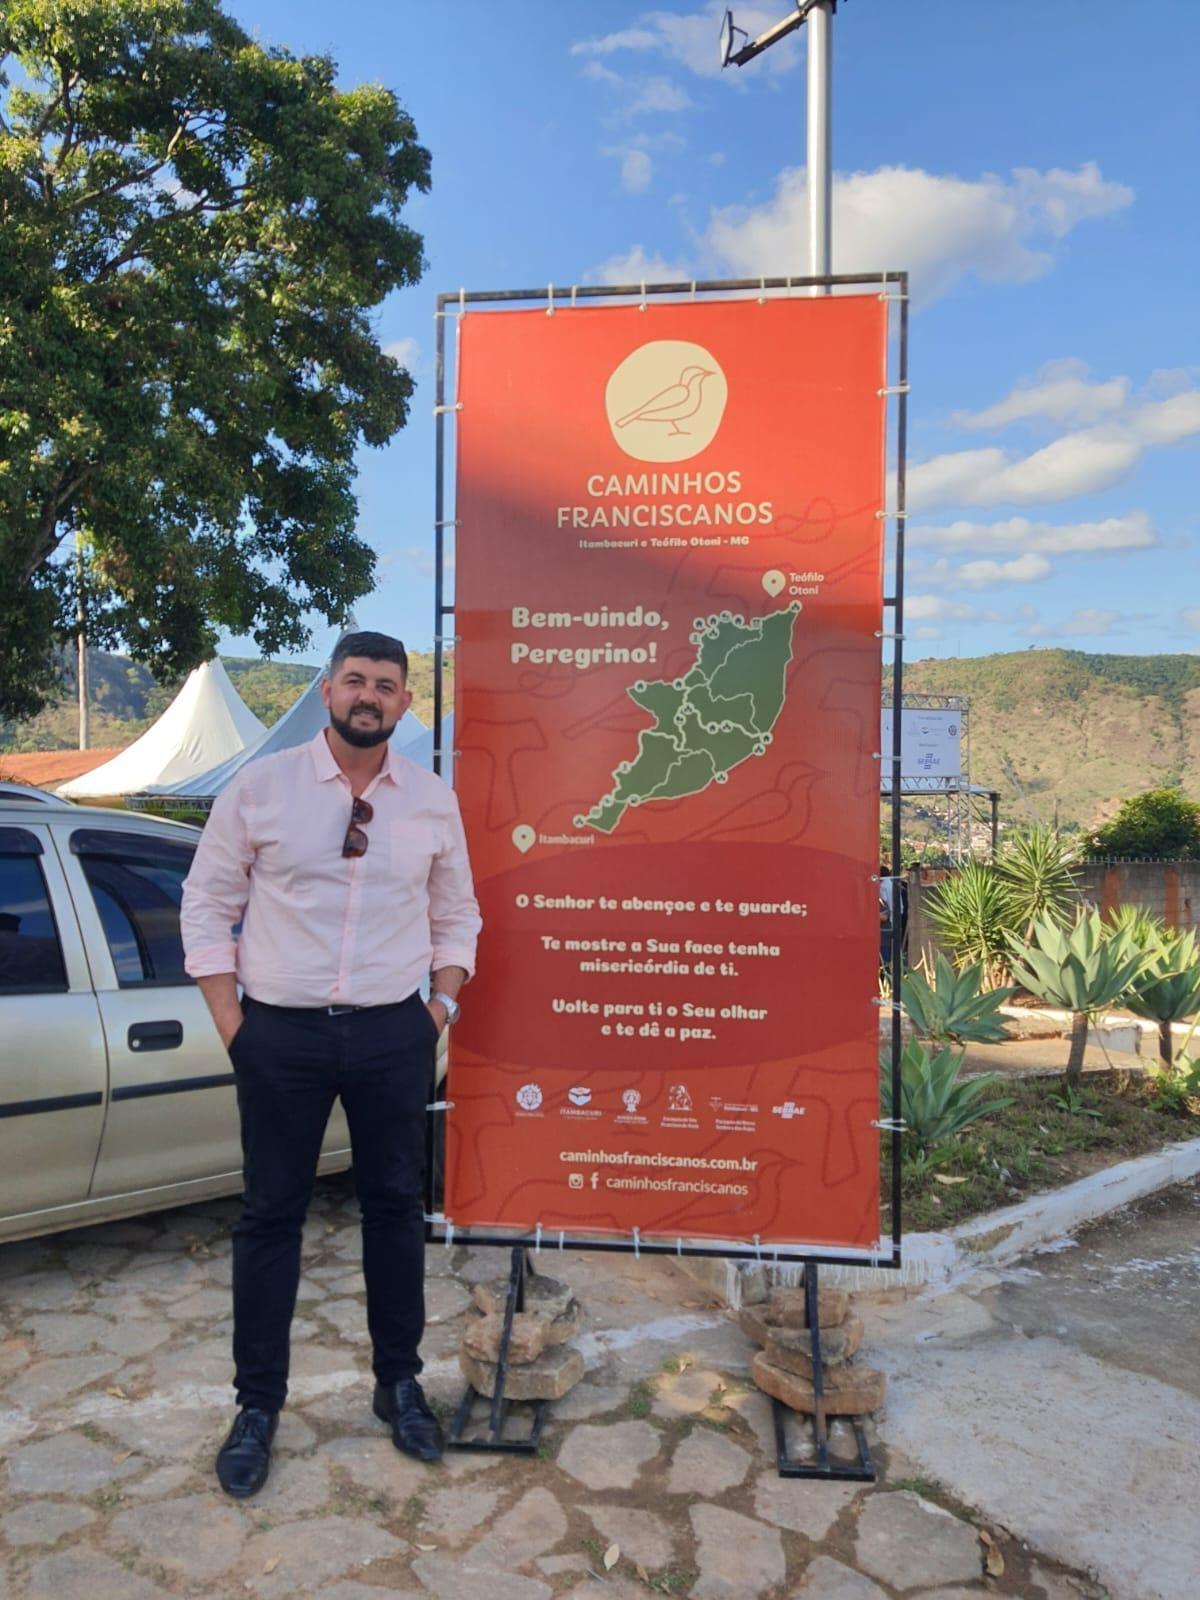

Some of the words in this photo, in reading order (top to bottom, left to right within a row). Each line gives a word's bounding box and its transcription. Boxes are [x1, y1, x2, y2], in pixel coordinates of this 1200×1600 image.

[587, 471, 742, 496] CAMINHOS
[557, 502, 773, 528] FRANCISCANOS
[579, 539, 638, 549] Itambacuri
[650, 537, 687, 547] Teófilo
[690, 537, 721, 546] Otoni
[730, 536, 749, 545] MG
[789, 572, 824, 582] Teófilo
[789, 586, 818, 595] Otoni
[510, 642, 657, 669] Peregrino!
[539, 833, 594, 844] Itambacuri
[516, 894, 528, 908] O
[534, 895, 595, 910] Senhor
[600, 897, 618, 910] te
[622, 897, 695, 916] abençoe
[700, 902, 710, 912] e
[715, 899, 734, 912] te
[739, 901, 807, 917] guarde;
[541, 936, 560, 950] Te
[565, 938, 626, 952] mostre
[631, 942, 642, 952] a
[647, 939, 680, 953] Sua
[685, 940, 723, 955] face
[729, 943, 780, 956] tenha
[580, 959, 689, 975] misericórdia
[694, 962, 715, 976] de
[720, 963, 738, 976] ti.
[604, 1003, 644, 1017] para
[649, 1002, 662, 1016] ti
[667, 1005, 678, 1017] o
[683, 1003, 715, 1019] Seu
[720, 1006, 767, 1020] olhar
[601, 1025, 611, 1036] e
[616, 1023, 634, 1037] te
[639, 1023, 660, 1038] dê
[665, 1028, 675, 1038] a
[680, 1028, 716, 1041] paz.
[559, 1150, 758, 1171] caminhosfranciscanos.com.br
[606, 1175, 748, 1196] caminhosfranciscanos
